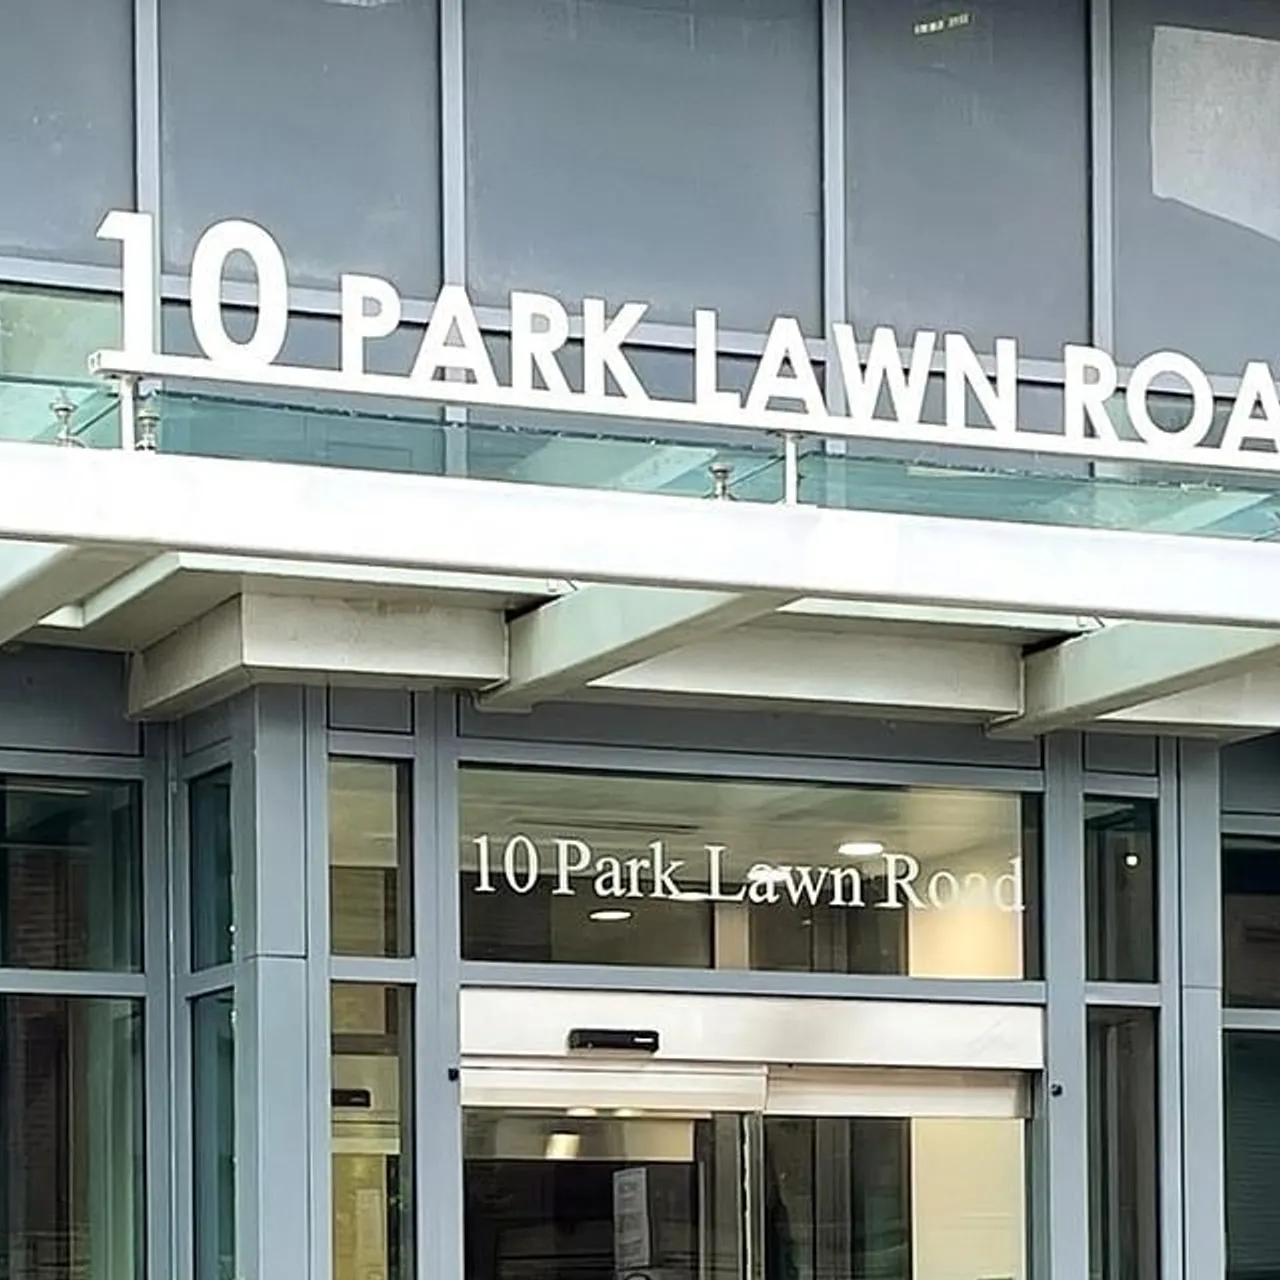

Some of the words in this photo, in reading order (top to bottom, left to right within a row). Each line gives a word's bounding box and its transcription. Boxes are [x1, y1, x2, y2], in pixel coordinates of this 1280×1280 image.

[96, 209, 288, 369] 10
[339, 272, 651, 402] PARK
[693, 309, 1018, 434] LAWN
[472, 832, 539, 893] 10
[551, 837, 686, 899] Park
[703, 843, 866, 907] Lawn
[874, 852, 1025, 912] Road
